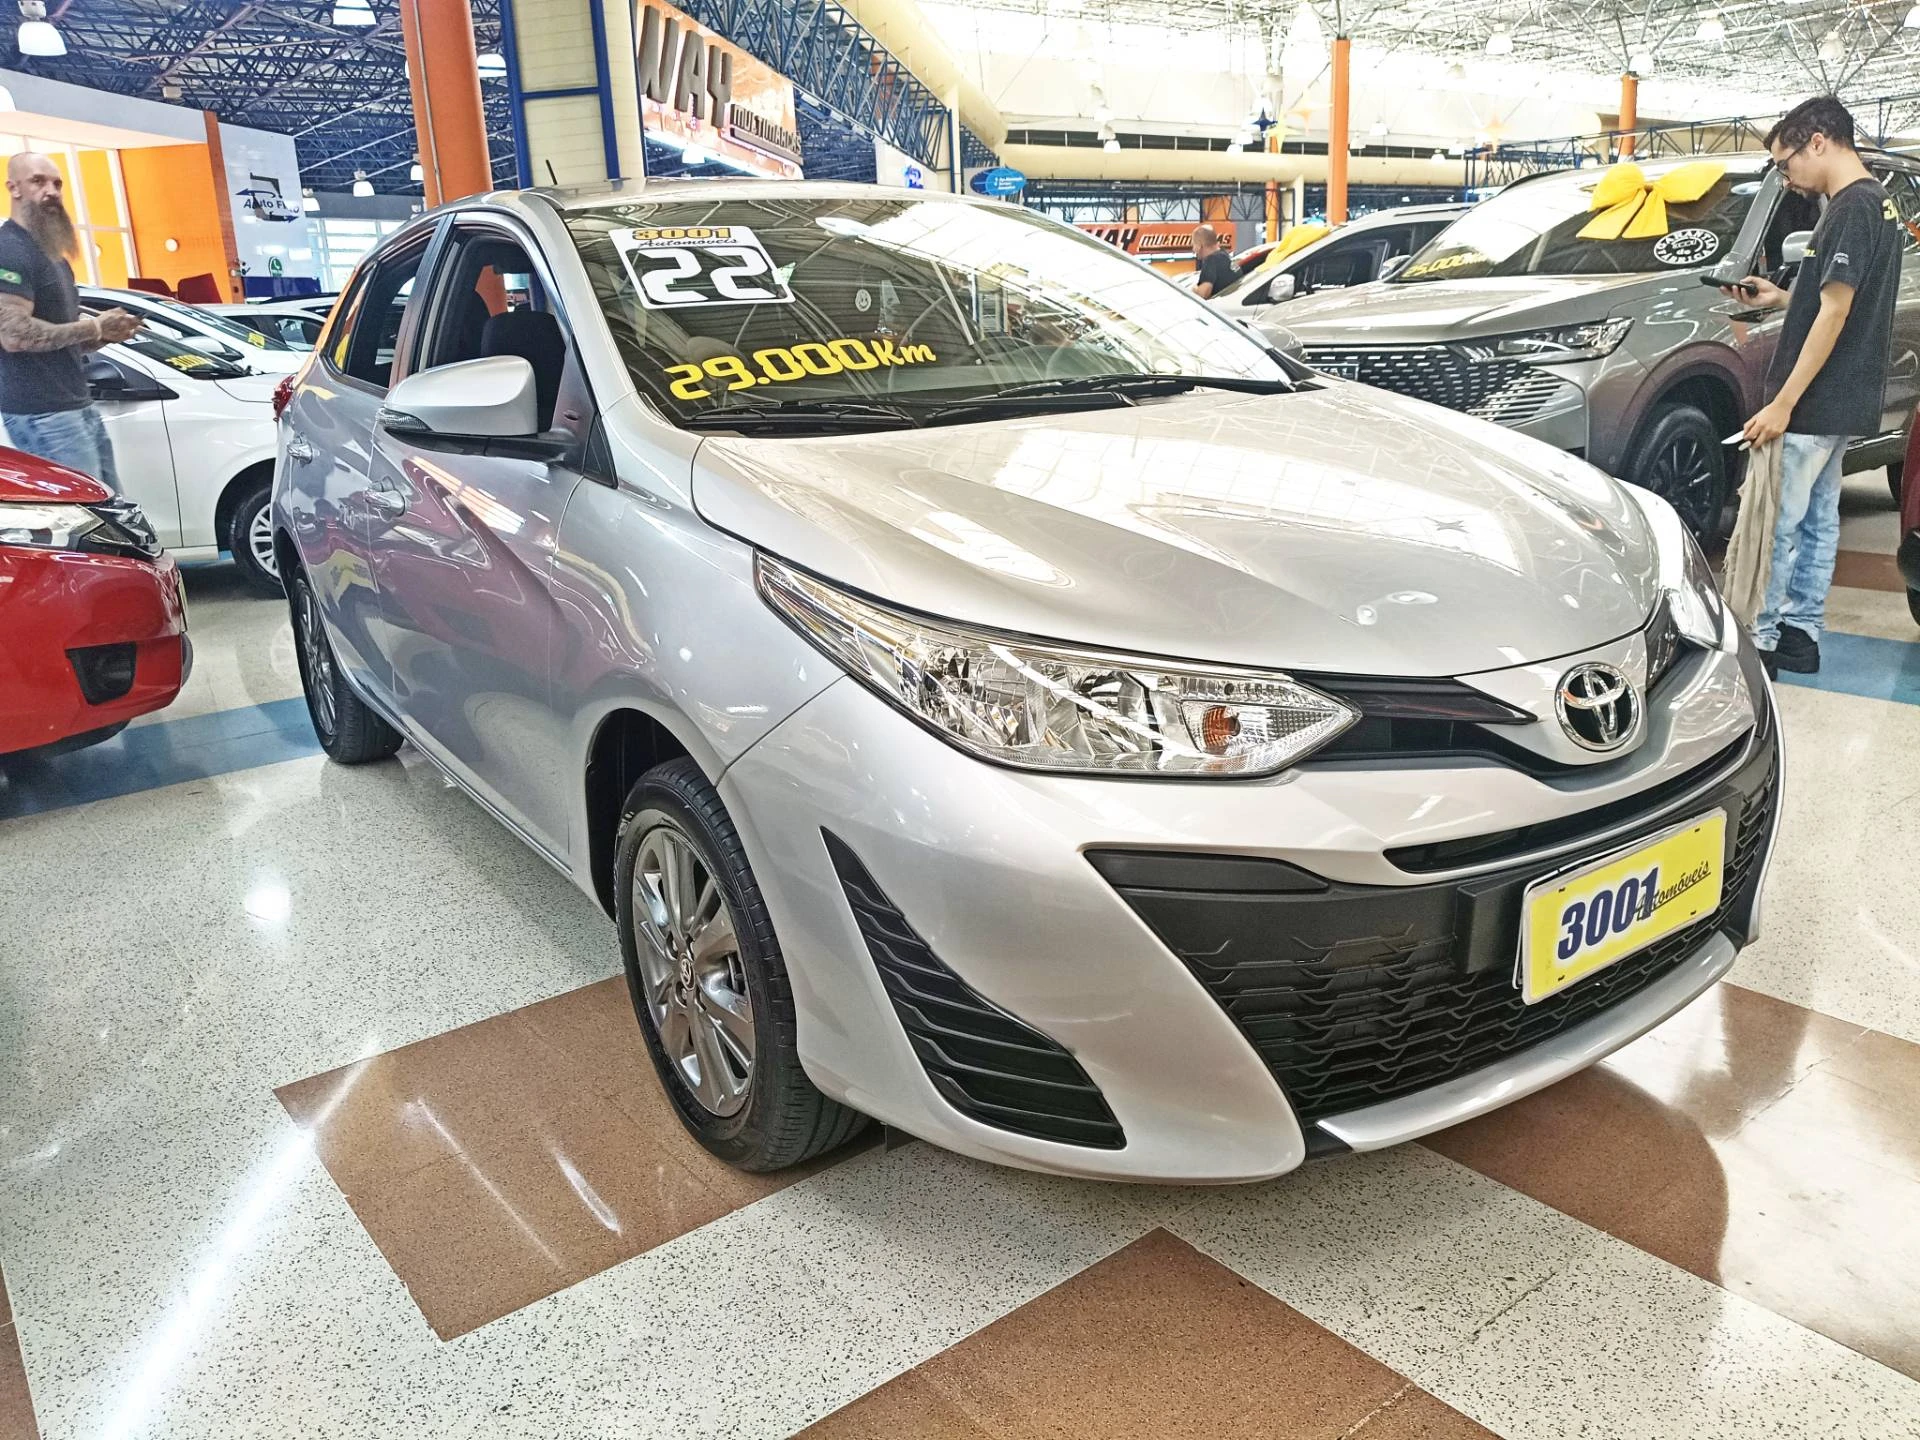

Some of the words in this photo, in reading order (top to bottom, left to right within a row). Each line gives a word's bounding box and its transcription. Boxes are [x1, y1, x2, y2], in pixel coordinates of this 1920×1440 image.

[632, 227, 732, 241] 3001
[1139, 233, 1232, 248] MULTIMAS
[641, 248, 777, 303] 22
[664, 339, 936, 400] 29.000Km
[1557, 866, 1659, 960] 3001
[1636, 860, 1712, 922] Atomóveis
